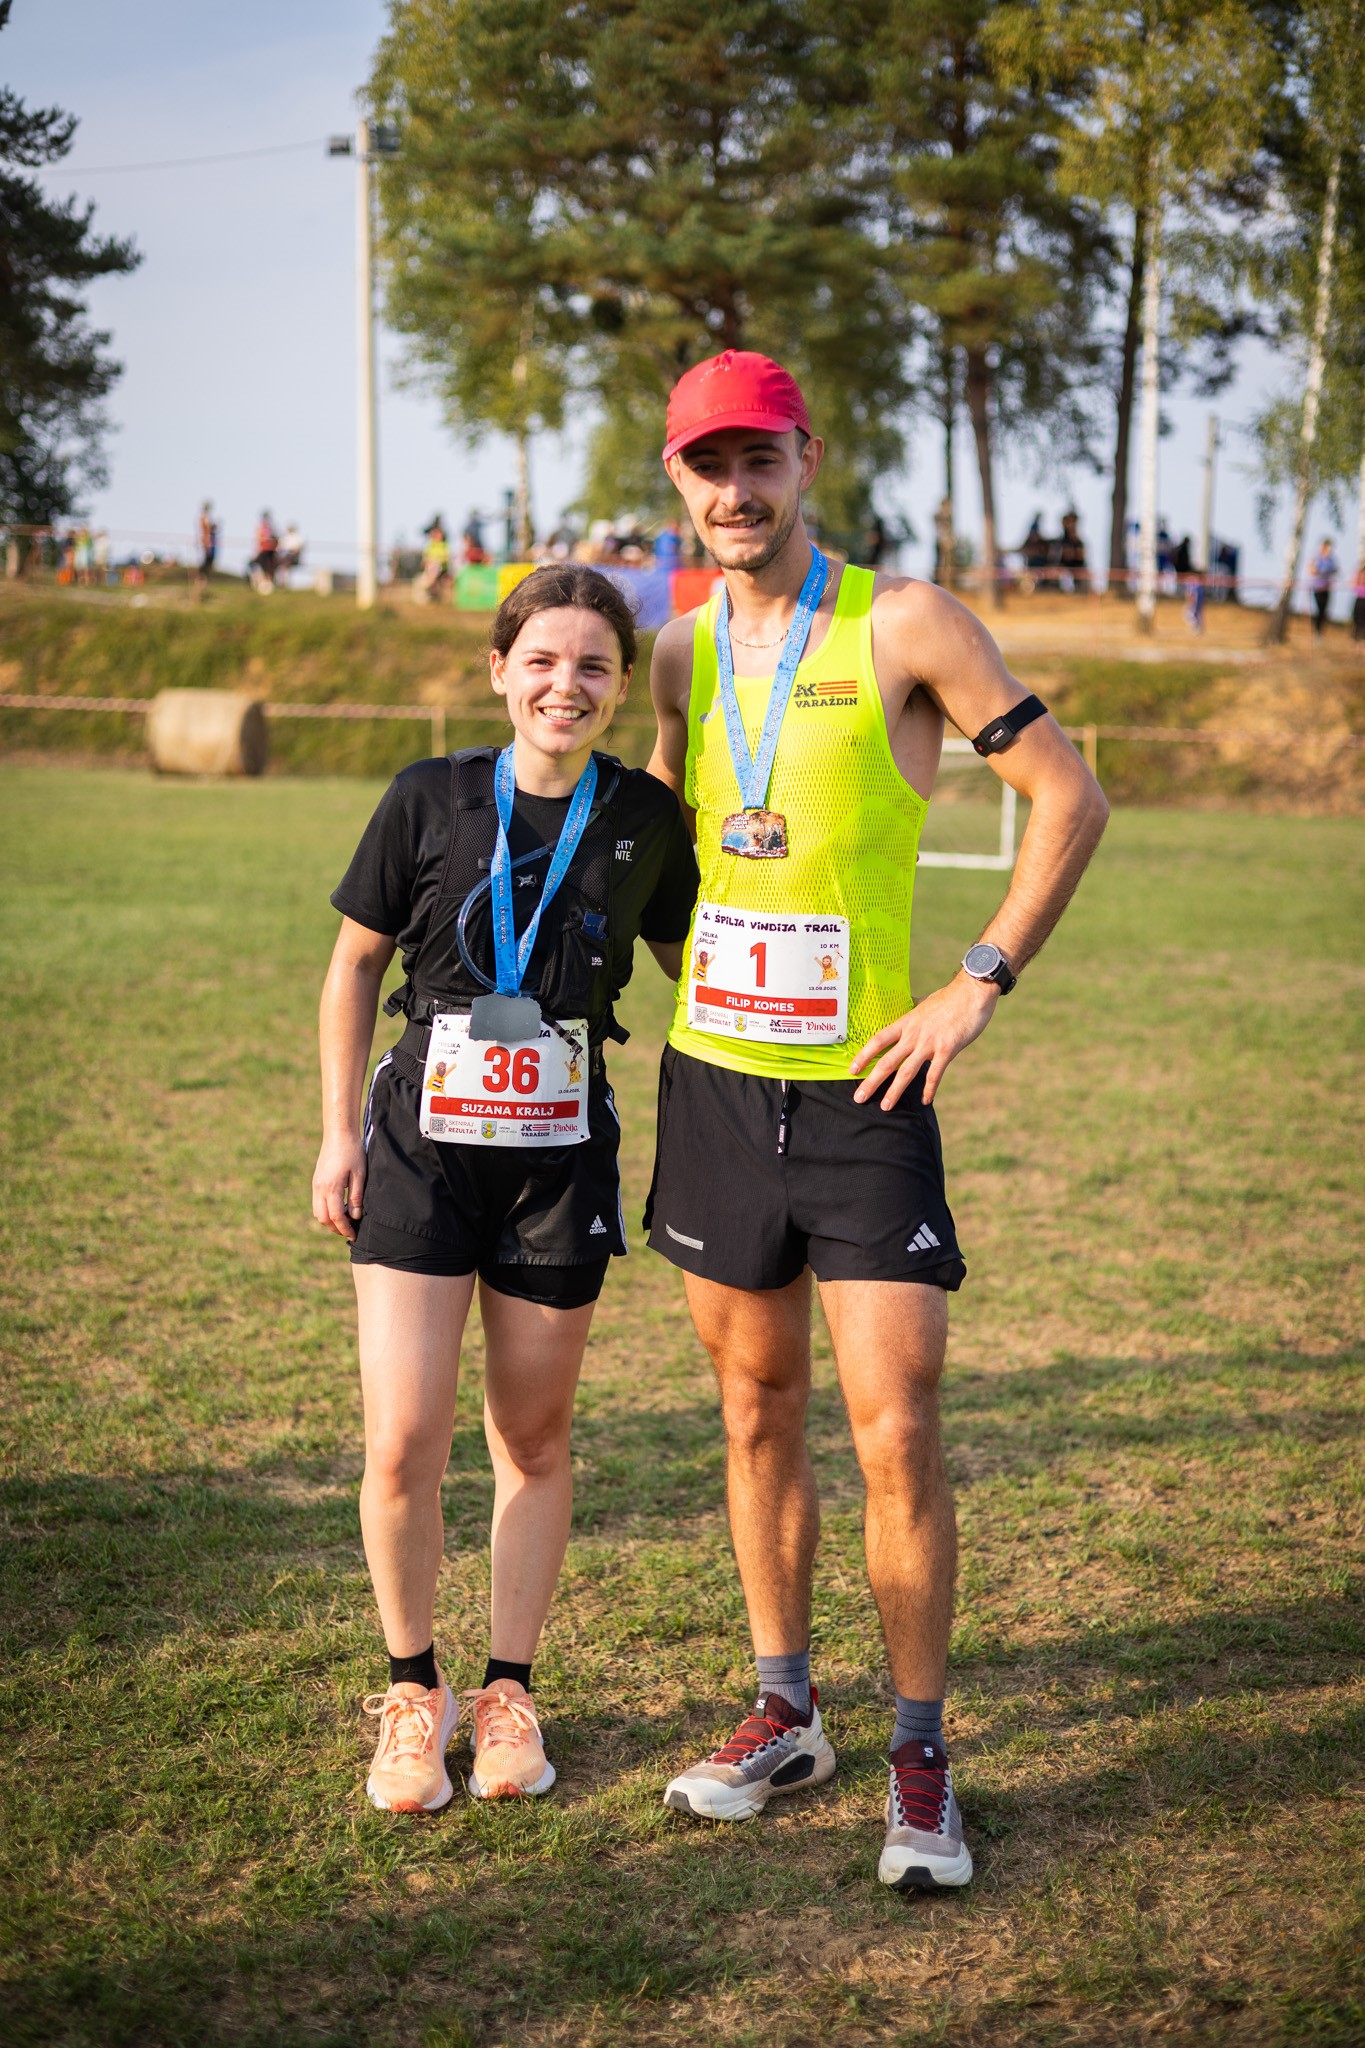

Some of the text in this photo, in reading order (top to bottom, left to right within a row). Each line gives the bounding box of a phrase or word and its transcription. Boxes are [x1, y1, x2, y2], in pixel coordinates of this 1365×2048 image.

[795, 696, 858, 708] VARAŽDIN
[702, 911, 711, 921] 4.
[749, 941, 767, 988] 1
[725, 995, 795, 1013] FILIP KOMES
[708, 1017, 732, 1027] REZULTAT
[806, 1021, 836, 1032] Vindija
[482, 1045, 541, 1095] 36
[461, 1103, 555, 1117] SUZANA KRALJ
[448, 1127, 478, 1135] REZULTAT
[553, 1123, 578, 1133] Vindija
